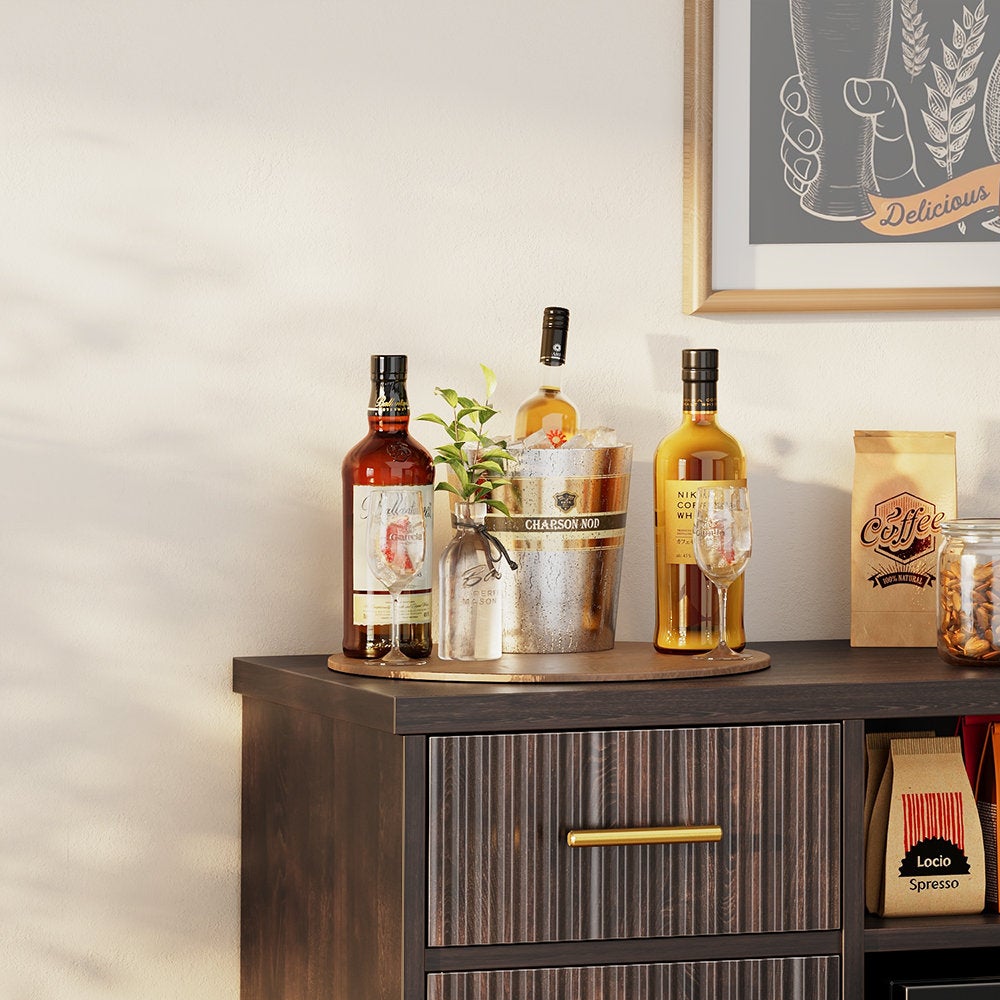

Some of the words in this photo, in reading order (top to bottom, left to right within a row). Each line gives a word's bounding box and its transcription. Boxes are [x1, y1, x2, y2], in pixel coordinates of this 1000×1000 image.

[879, 185, 991, 227] Delicious
[677, 491, 697, 499] NIK
[860, 507, 946, 545] Coffee
[882, 576, 898, 585] 100%
[898, 574, 923, 585] NATURAL
[917, 854, 952, 868] Locio
[909, 878, 960, 893] Spresso
